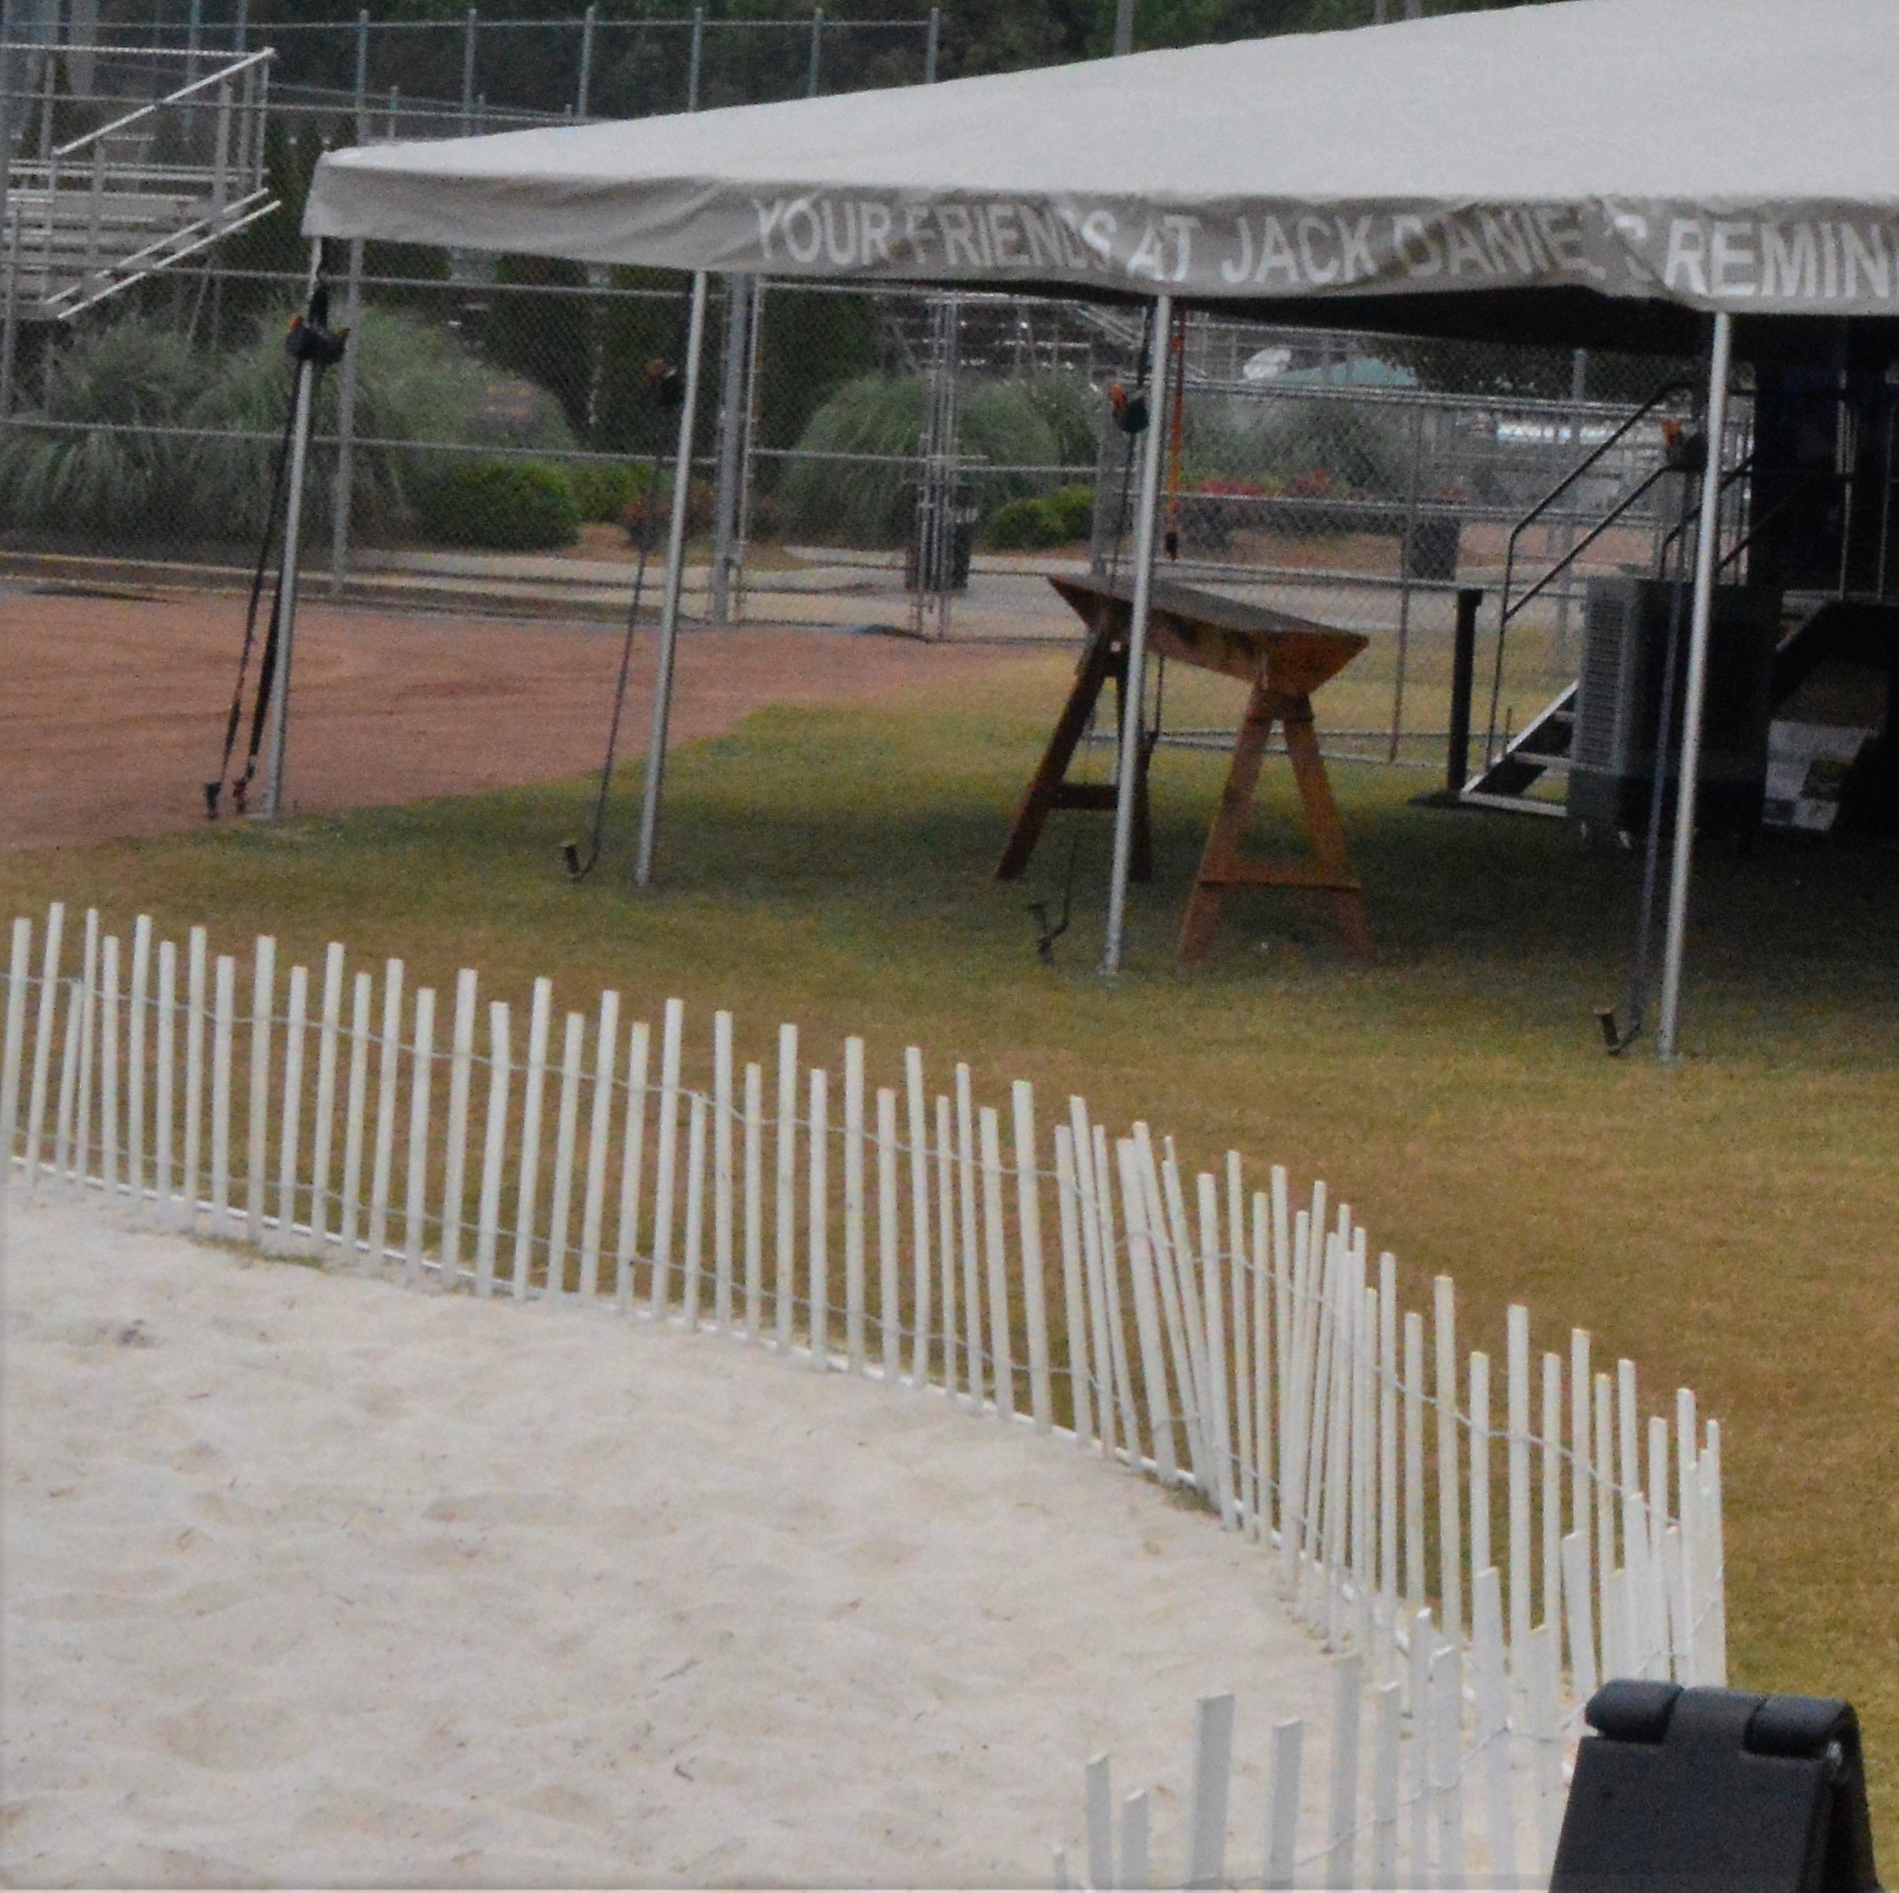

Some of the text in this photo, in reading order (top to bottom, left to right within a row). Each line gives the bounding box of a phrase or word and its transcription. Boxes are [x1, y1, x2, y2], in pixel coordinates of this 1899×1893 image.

[754, 198, 892, 266] YOUR
[1127, 214, 1199, 283] AT
[1221, 214, 1378, 284] JACK
